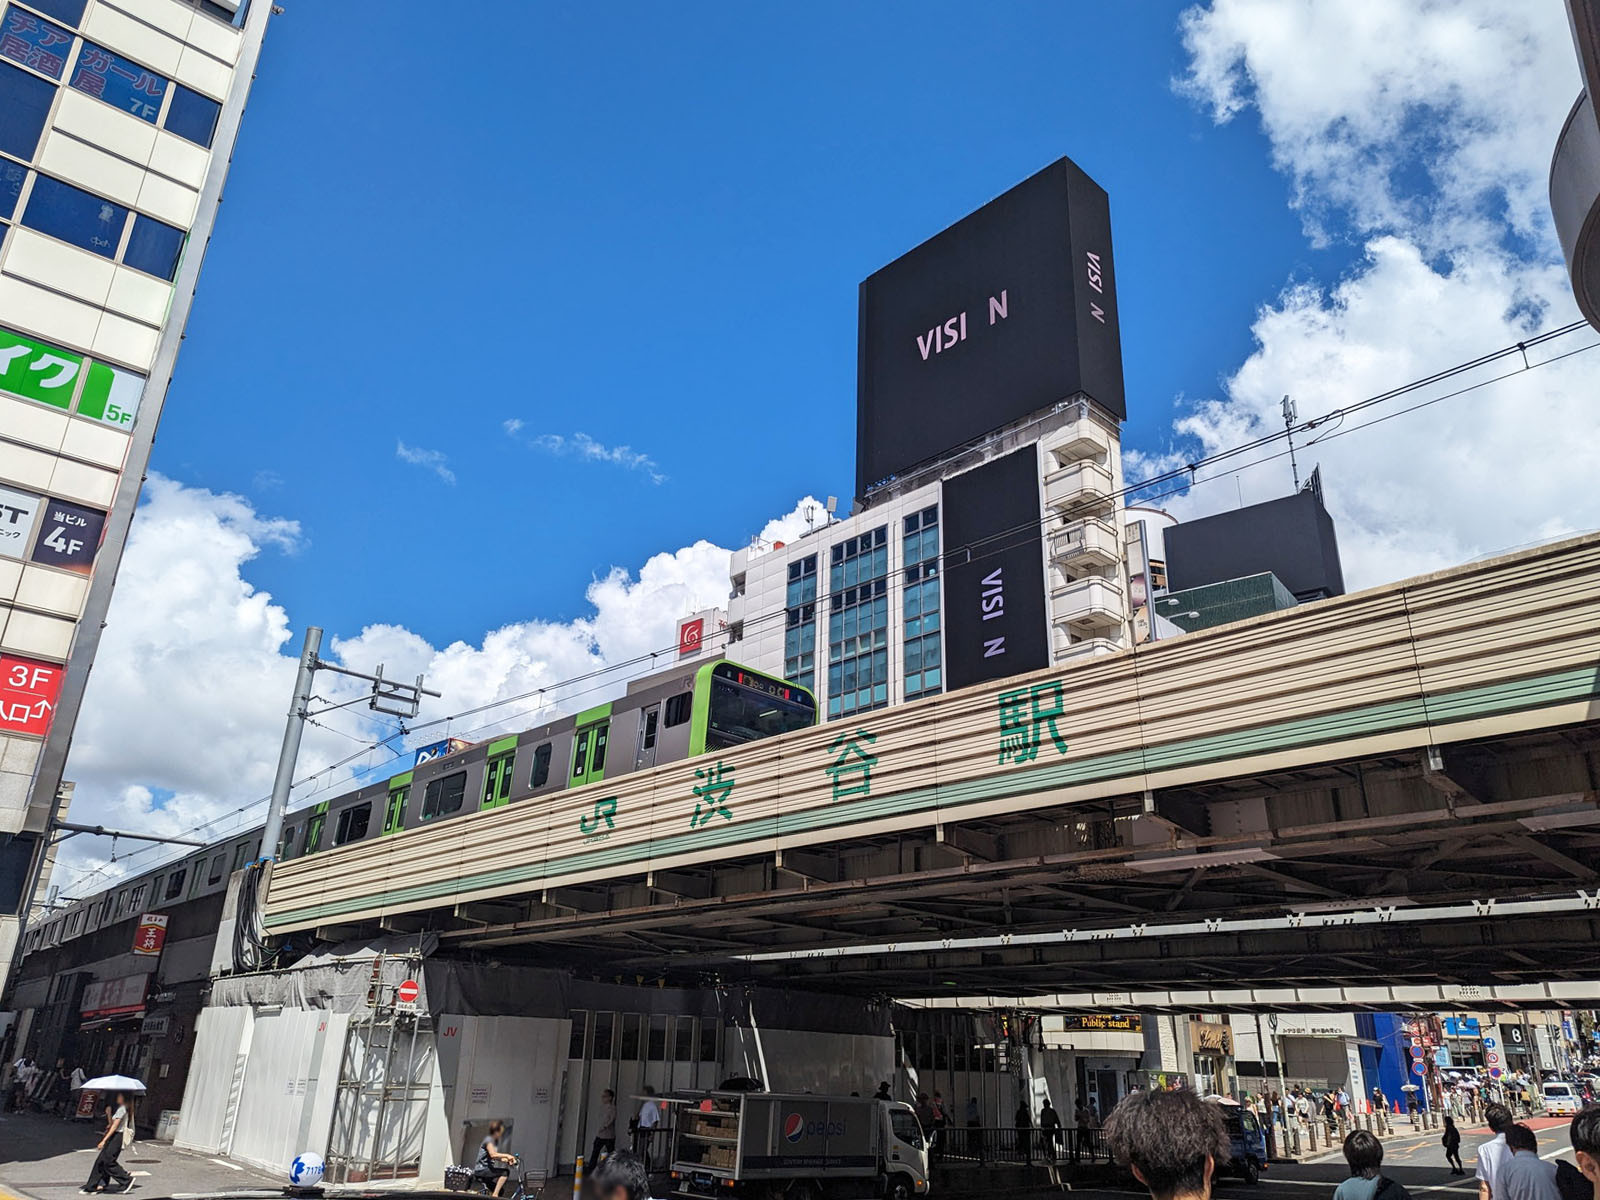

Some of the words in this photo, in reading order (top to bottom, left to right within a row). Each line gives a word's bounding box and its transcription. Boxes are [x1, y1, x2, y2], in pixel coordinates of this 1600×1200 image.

[0, 32, 106, 99] 居酒屋
[129, 97, 157, 118] 7F
[106, 403, 132, 424] 5F
[53, 511, 87, 527] 当ビル
[44, 526, 84, 555] 4F
[9, 665, 53, 689] 3F
[580, 795, 617, 834] JR
[1108, 1017, 1130, 1029] stand
